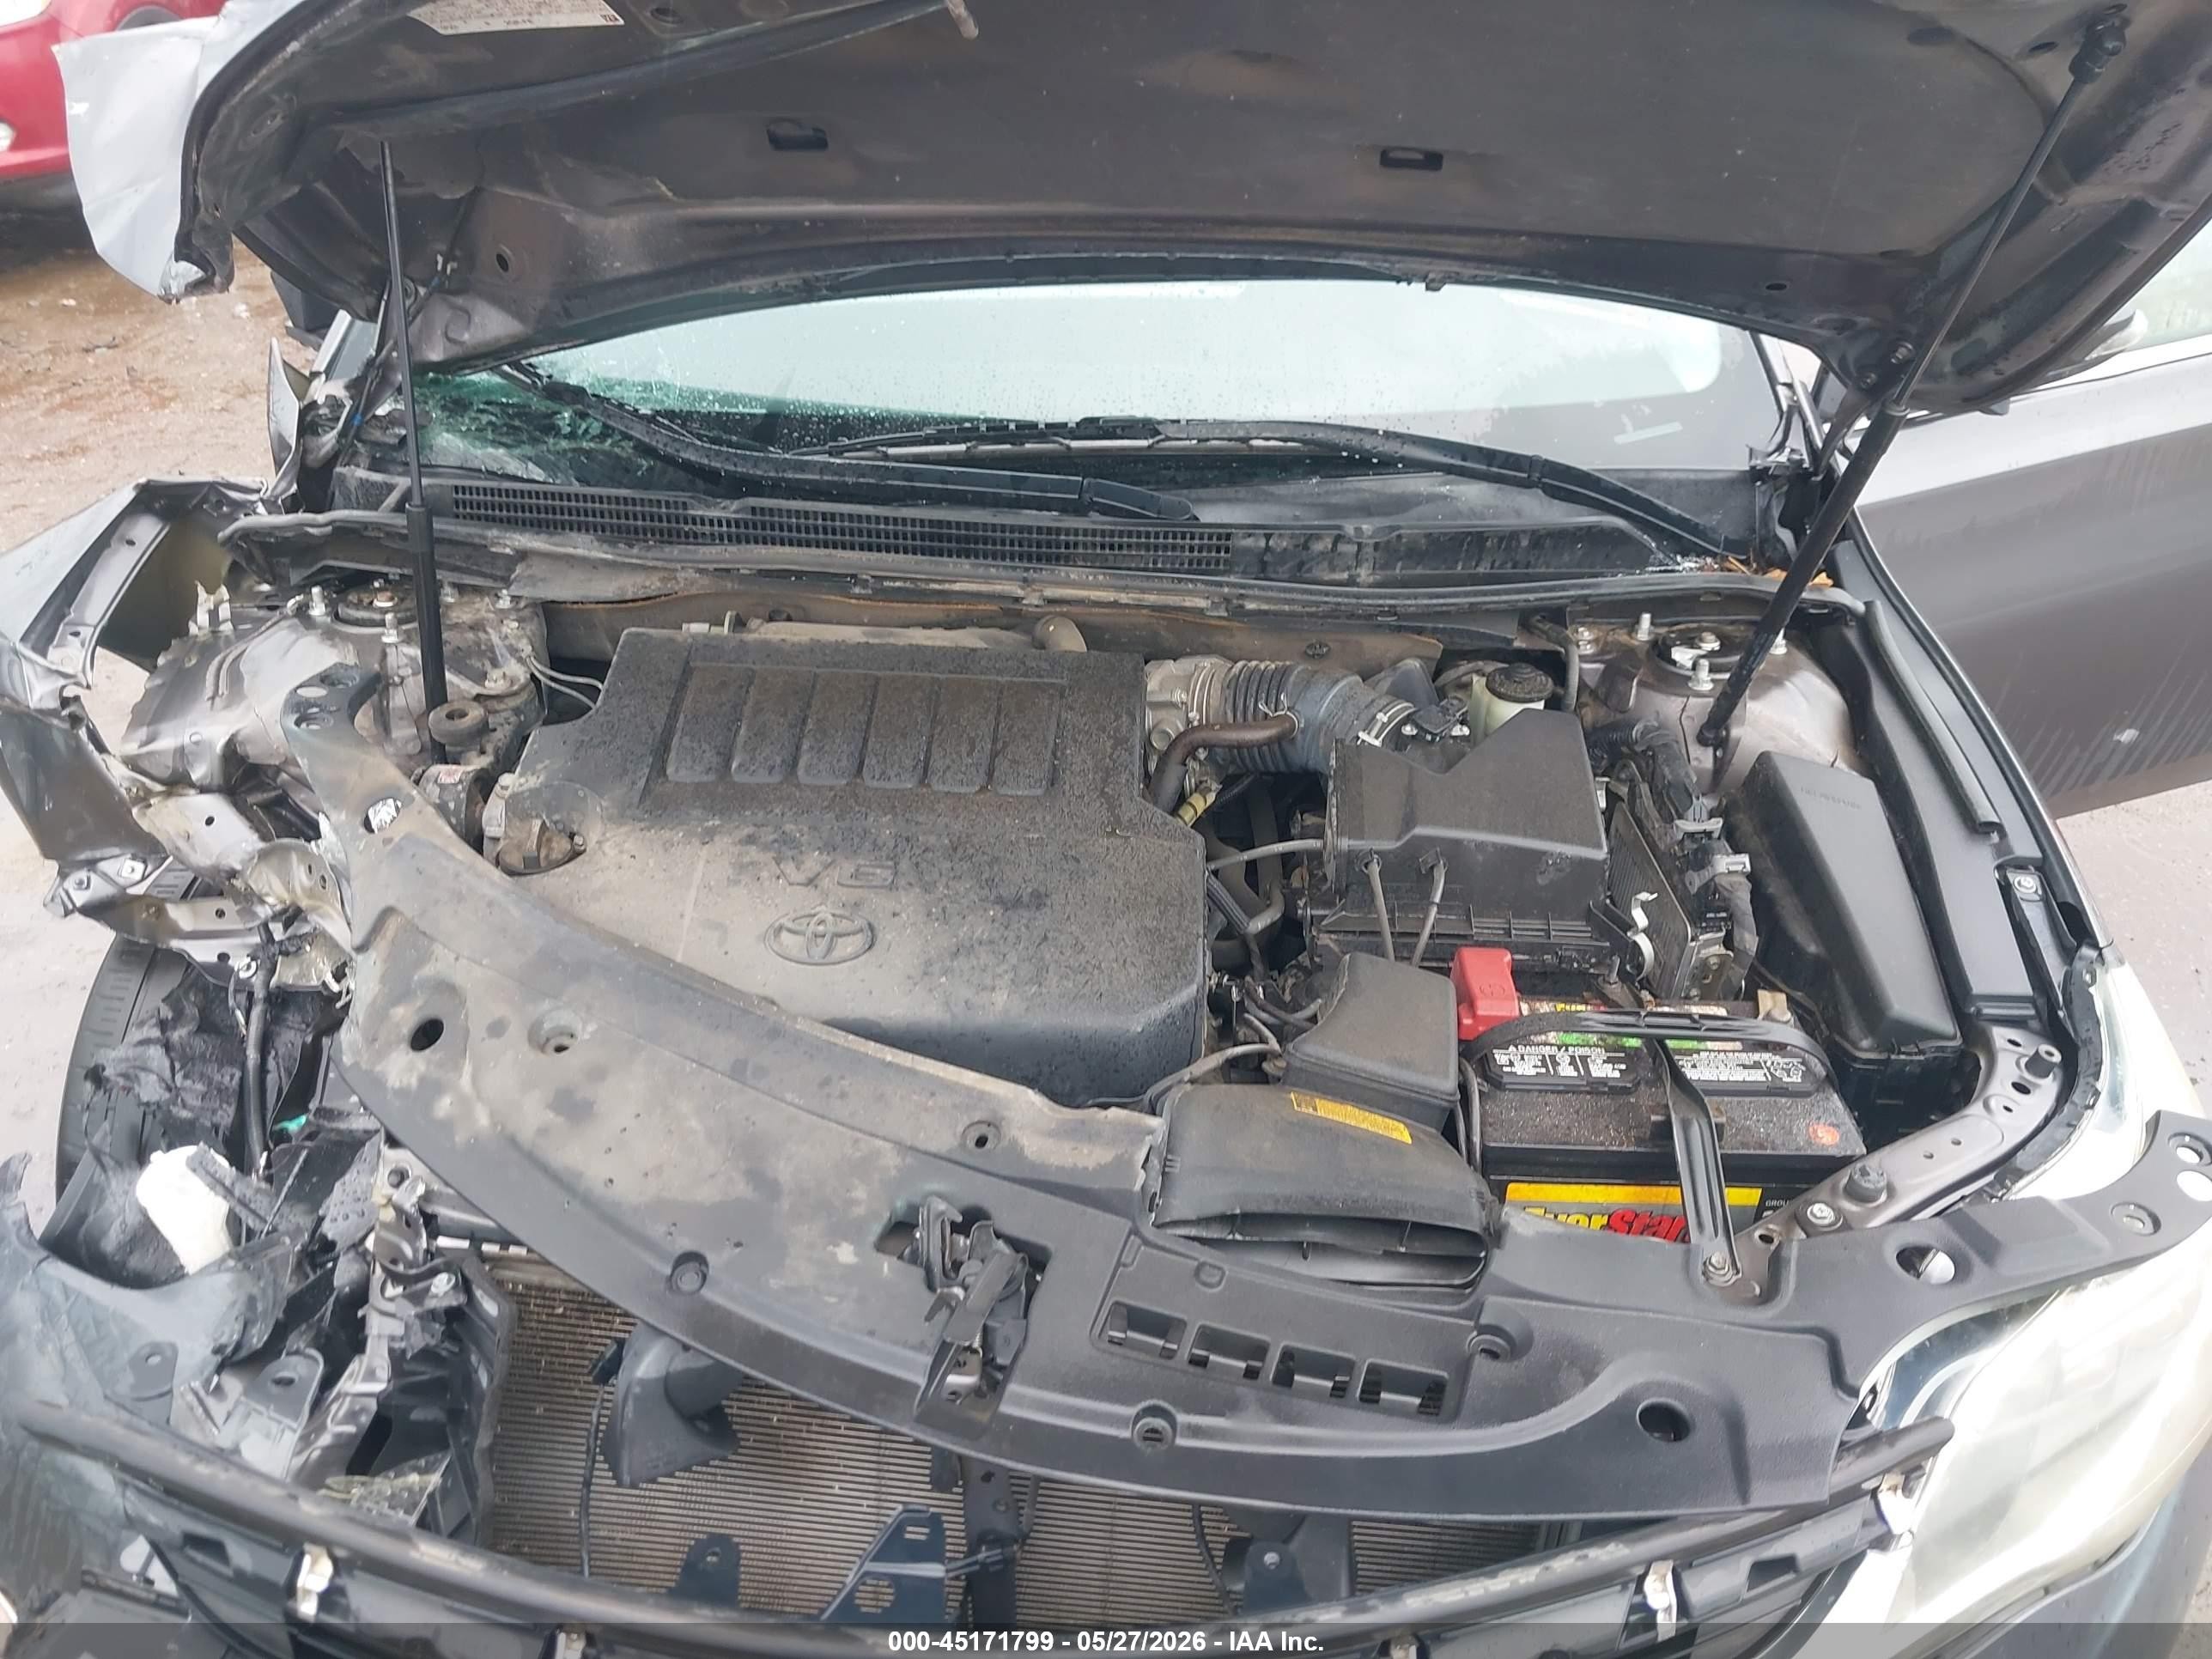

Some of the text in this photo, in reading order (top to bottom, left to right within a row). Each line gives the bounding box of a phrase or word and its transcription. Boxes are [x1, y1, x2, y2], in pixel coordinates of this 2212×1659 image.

[770, 853, 896, 888] V6
[1568, 1046, 1605, 1054] POISON
[1765, 1199, 1790, 1207] GROU
